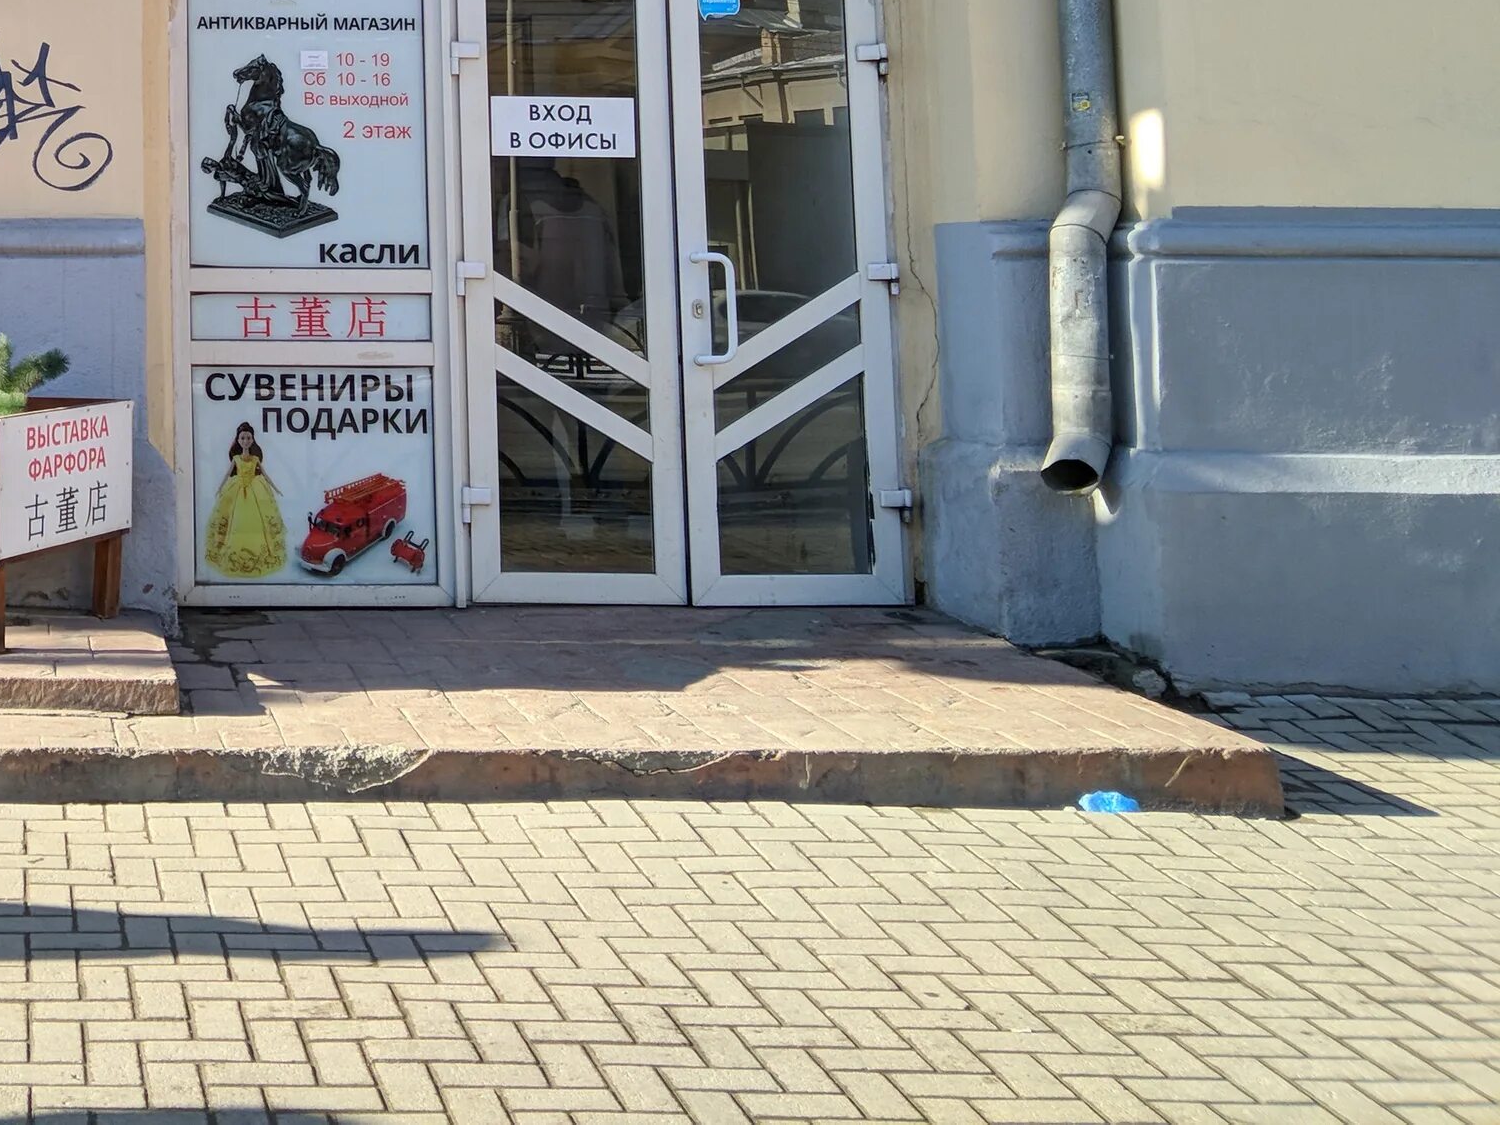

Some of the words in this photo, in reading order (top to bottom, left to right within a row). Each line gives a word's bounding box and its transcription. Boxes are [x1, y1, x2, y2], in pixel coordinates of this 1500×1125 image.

[197, 13, 329, 31] АНТИКВАРНЫЙ
[333, 17, 416, 31] МАГАЗИН
[336, 52, 355, 67] 10
[371, 52, 390, 67] 19
[303, 71, 326, 86] Сб
[337, 72, 356, 86] 10
[372, 72, 391, 87] 16
[304, 91, 325, 106] Вс
[329, 92, 409, 108] выходной
[528, 104, 592, 126] ВХОД
[343, 120, 355, 139] 2
[361, 124, 412, 139] этаж
[510, 133, 522, 150] В
[527, 131, 617, 151] ОФИСЫ
[319, 242, 421, 265] касли
[235, 296, 388, 339] 古董店
[204, 373, 415, 403] СУВЕНИРЫ
[26, 415, 109, 451] ВЫСТАВКА
[261, 407, 429, 441] ПОДАРКИ
[28, 446, 107, 482] ФАРФОРА
[24, 480, 109, 542] 古董店
